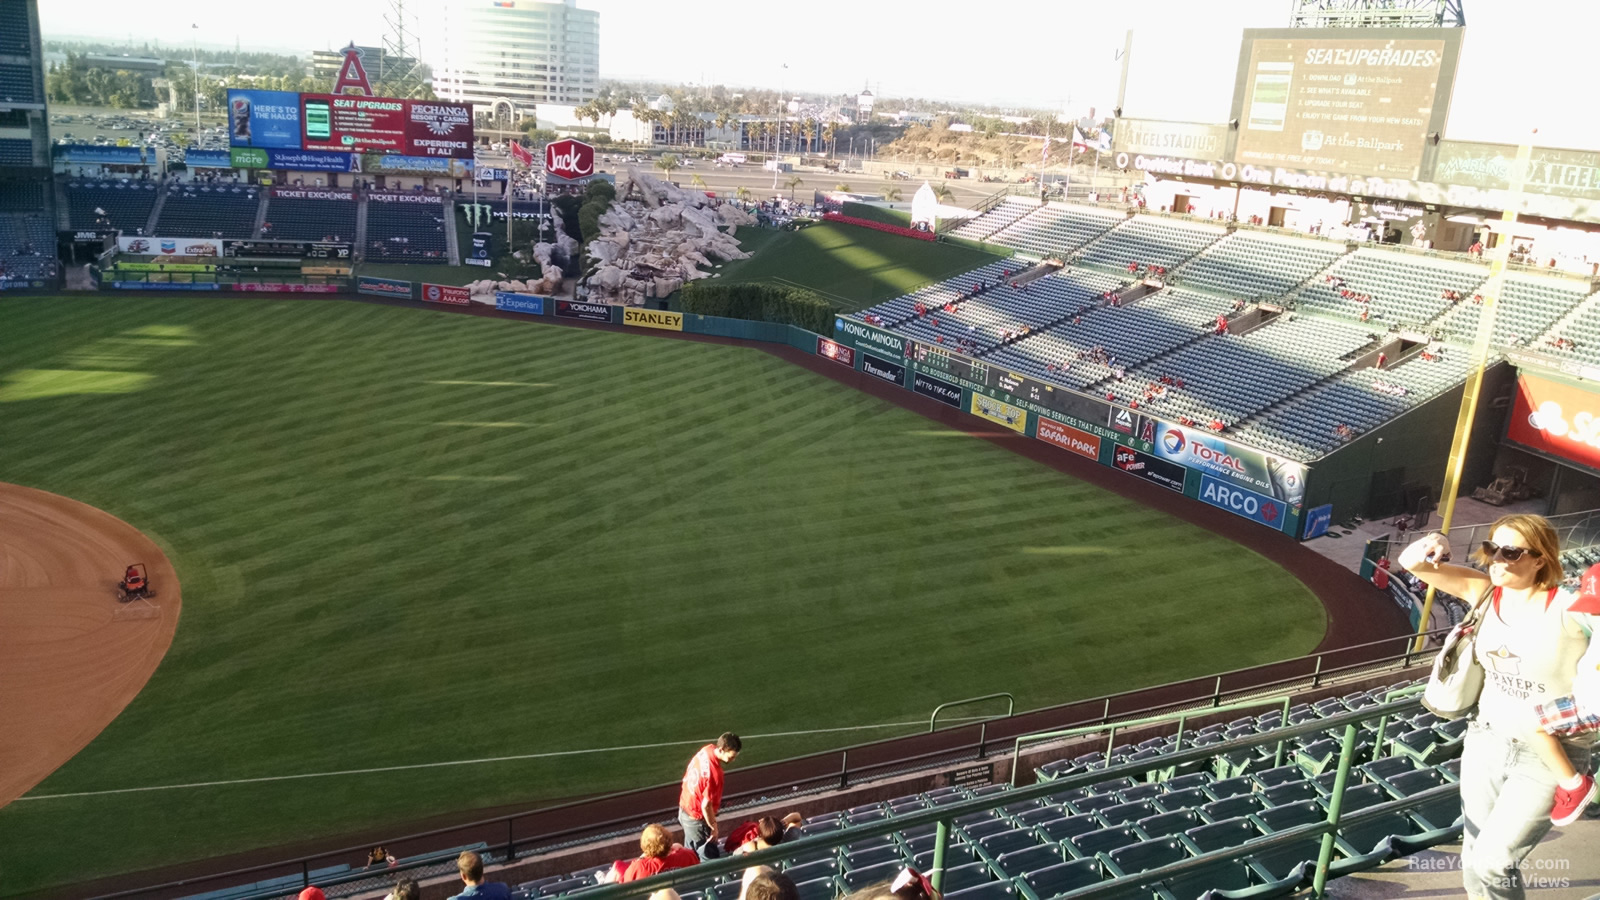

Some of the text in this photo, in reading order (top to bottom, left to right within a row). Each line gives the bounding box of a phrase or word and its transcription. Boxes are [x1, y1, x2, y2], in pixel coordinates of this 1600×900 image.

[1304, 48, 1437, 67] SEAT UPGRADES
[1309, 74, 1342, 82] DOWNLOAD
[1340, 88, 1372, 96] AVAILABLE
[253, 104, 298, 115] HERE'S TO
[333, 99, 403, 111] SEAT UPGRADES
[411, 103, 469, 117] PECHANGA
[1304, 99, 1331, 107] UPGRADE
[1348, 101, 1364, 109] SEAT
[255, 112, 298, 121] THE HALOS
[1332, 113, 1349, 121] GAME
[1349, 114, 1368, 122] FROM
[1368, 115, 1385, 123] YOUR
[1385, 116, 1401, 124] NEW
[1401, 117, 1424, 126] SEATS!
[372, 138, 397, 146] Ballpark
[413, 139, 467, 149] EXPERIENCE
[1125, 127, 1217, 152] ANGEL STADIUM
[1324, 131, 1404, 151] At the Ballpark
[235, 155, 263, 164] more
[547, 144, 593, 175] Jack
[1242, 150, 1275, 159] DOWNLOAD
[1287, 153, 1303, 161] FREE
[1315, 156, 1337, 164] TODAY
[1134, 155, 1217, 177] OneWest Bank
[1442, 153, 1600, 188] MARLINS ANGEL
[1273, 167, 1327, 190] Person
[1328, 176, 1348, 192] at
[275, 190, 307, 198] TICKET
[369, 193, 399, 202] TICKET
[492, 211, 553, 219] MONSTER
[442, 287, 470, 296] Insuranc
[505, 298, 539, 310] Experian
[569, 302, 608, 315] YOKOHAMA
[625, 310, 681, 327] STANLEY
[843, 321, 903, 351] KONICA MINOLTA
[864, 361, 897, 382] Thermador
[915, 378, 933, 391] NITTO
[930, 368, 959, 384] HOUSEHOLD
[959, 379, 985, 393] SERVICES
[976, 396, 1002, 412] SHOCK
[1005, 406, 1021, 419] TOP
[1016, 398, 1051, 417] SELF-MOVING
[1051, 411, 1077, 427] SERVICES
[1077, 420, 1093, 431] THAT
[1039, 427, 1097, 456] SAFARI PARK
[1116, 453, 1135, 463] aFe
[1190, 440, 1246, 472] TOTAL
[1125, 461, 1145, 471] POWER
[1188, 455, 1270, 489] PERFORMANCE ENGINE OILS
[1203, 482, 1259, 515] ARCO
